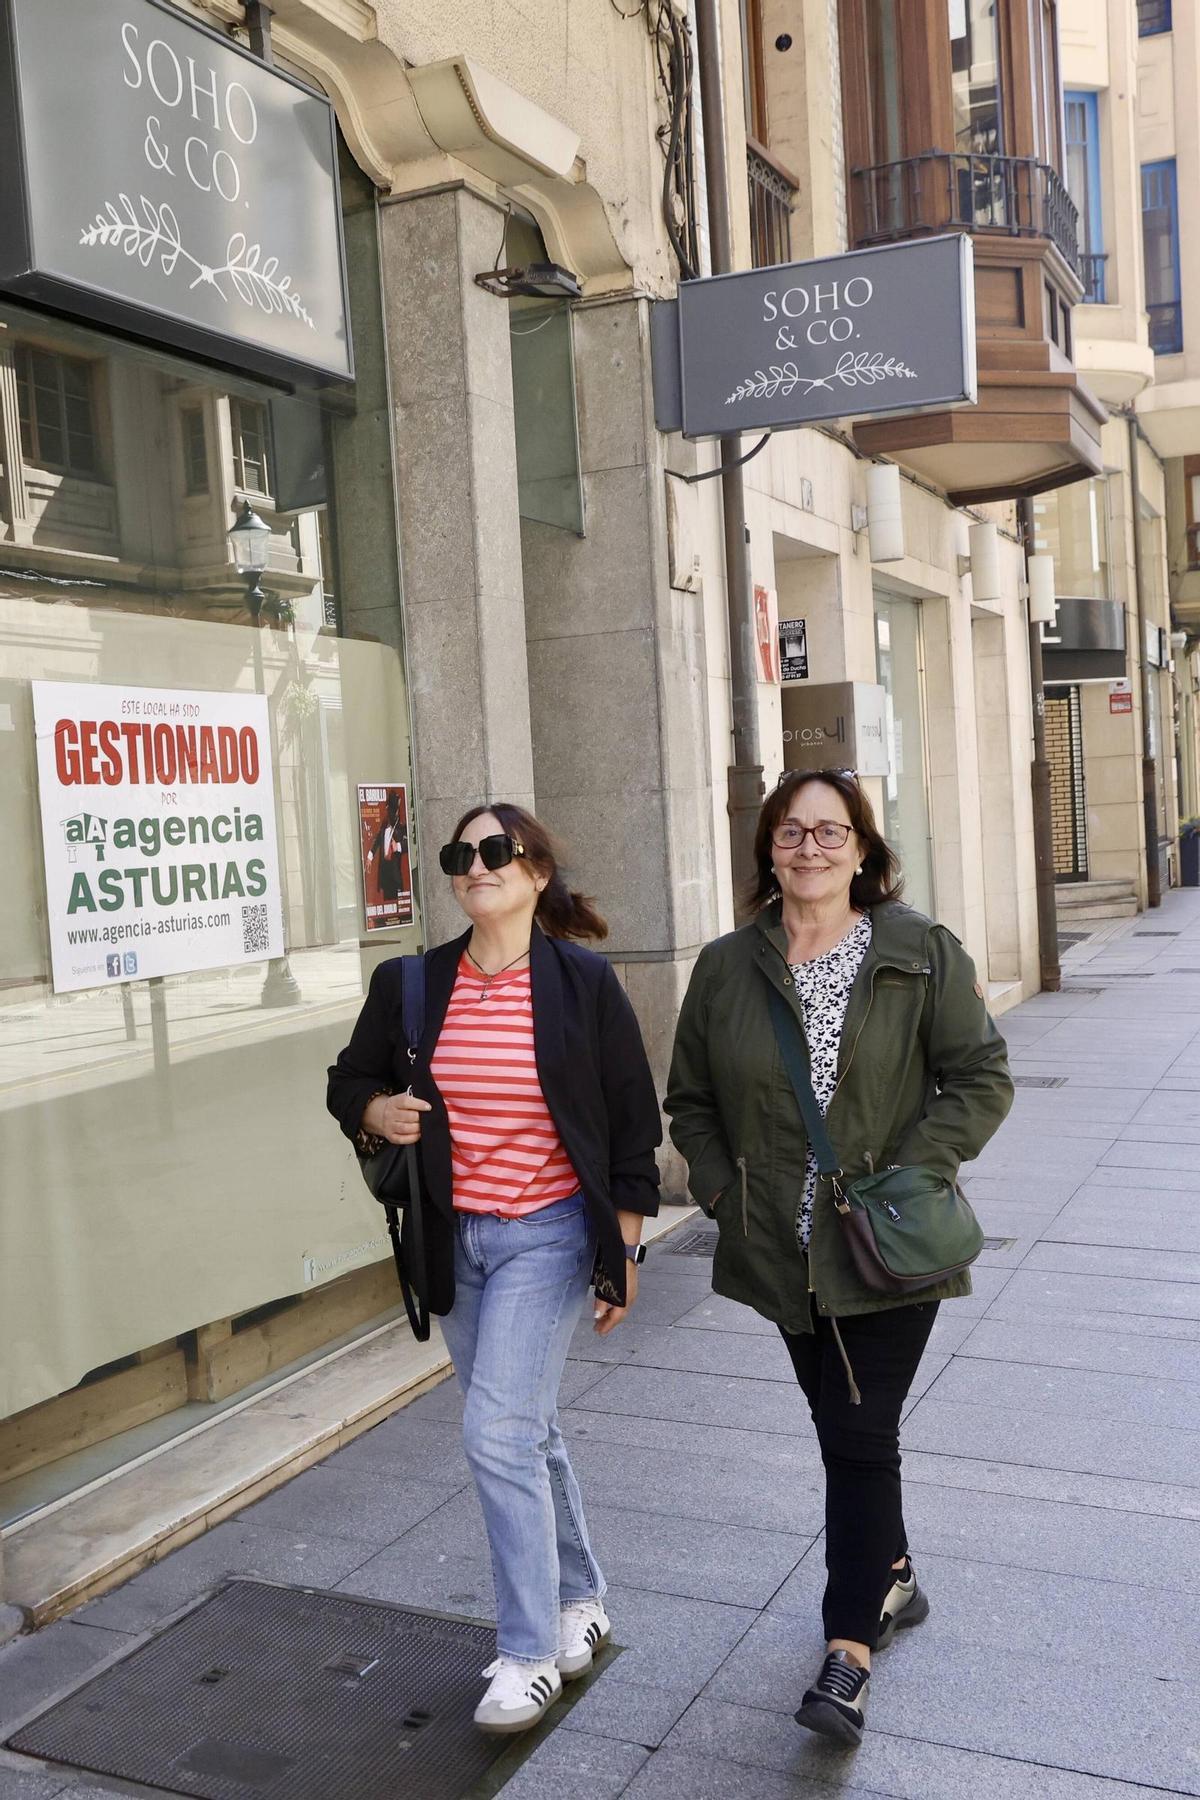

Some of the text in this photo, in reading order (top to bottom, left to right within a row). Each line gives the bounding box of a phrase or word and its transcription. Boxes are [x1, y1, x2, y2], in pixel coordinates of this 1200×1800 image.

[121, 22, 258, 144] SOHO
[144, 115, 249, 208] & CO.
[763, 276, 873, 322] SOHO
[775, 316, 861, 350] & CO.
[121, 700, 200, 717] ESTE LOCAL HA SIDO
[54, 718, 260, 786] GESTIONADO
[161, 791, 177, 806] POR
[112, 806, 264, 857] agencia
[67, 858, 267, 915] ASTURIAS
[67, 911, 231, 945] www.agencia-asturias.com
